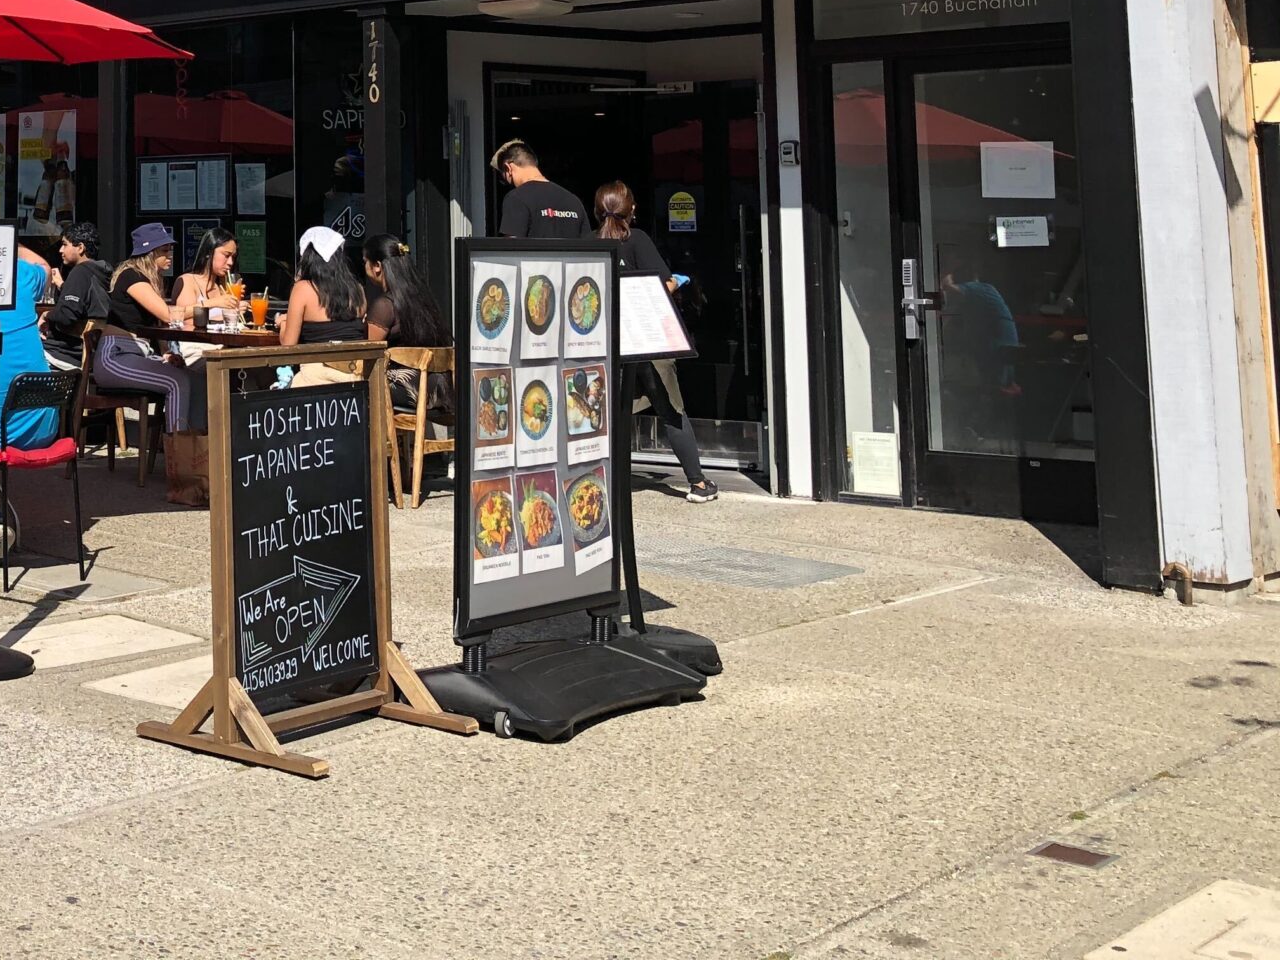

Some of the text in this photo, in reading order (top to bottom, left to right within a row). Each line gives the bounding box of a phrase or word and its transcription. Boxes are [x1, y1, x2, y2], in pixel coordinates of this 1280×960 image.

[901, 0, 939, 16] 1740
[368, 21, 380, 103] 1740
[242, 228, 260, 237] PASS
[248, 397, 361, 440] HOSHINOYA
[237, 438, 335, 488] JAPANESE
[286, 485, 299, 515] &
[240, 498, 364, 560] THAI CUISINE
[242, 589, 286, 625] We Are
[275, 595, 326, 644] OPEN
[312, 634, 371, 672] WELCOME
[239, 657, 299, 693] 4156103929
